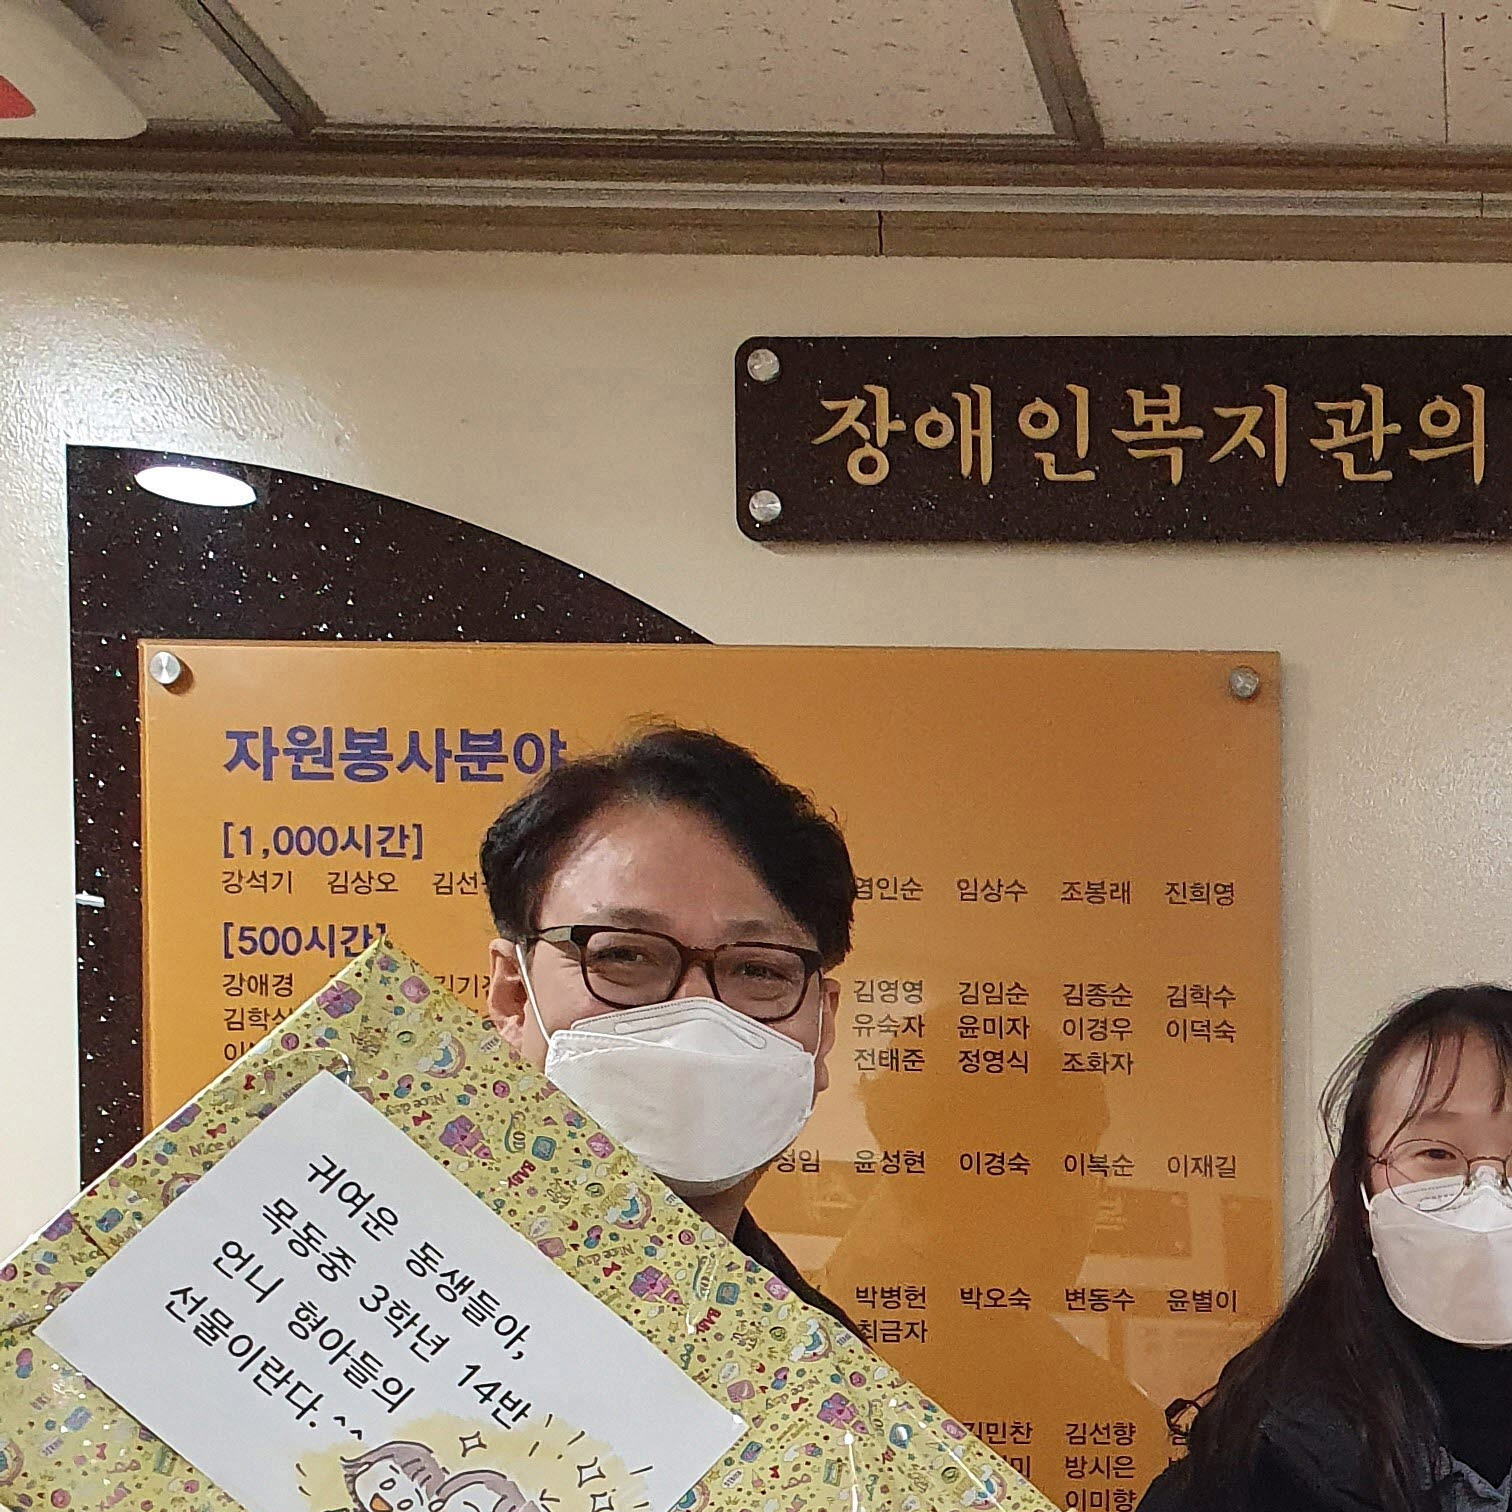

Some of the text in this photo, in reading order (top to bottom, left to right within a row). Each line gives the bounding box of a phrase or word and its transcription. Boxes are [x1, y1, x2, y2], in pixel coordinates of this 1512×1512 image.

[811, 384, 1484, 487] 장애인복지관의
[224, 725, 567, 783] 자원봉사분야
[223, 822, 424, 861] [1,000시간]
[222, 869, 292, 894] 강석기
[328, 870, 399, 895] 김상오
[957, 878, 1028, 903] 임상수
[1061, 881, 1130, 904] 조봉래
[1165, 882, 1234, 906] 진희영
[223, 973, 1236, 1009] 강애경 김영영 김임순 김종순 김학수
[852, 1014, 1236, 1043] 유숙자 윤미자 이경우 이덕숙
[854, 1048, 1134, 1075] 전태준 정영식 조화자
[960, 1152, 1031, 1175] 이경숙
[1065, 1153, 1135, 1177] 이복순
[1168, 1155, 1235, 1178] 이재길
[307, 1153, 530, 1362] 귀여운 동생들아,
[262, 1196, 532, 1431] 목동중 3학년 14반
[856, 1286, 1236, 1312] 박병헌 박오숙 변동수 윤별이
[213, 1238, 415, 1413] 언니 형아들의
[1066, 1422, 1136, 1445] 김선향
[1065, 1456, 1136, 1479] 방시은
[1065, 1489, 1137, 1512] 이미향
